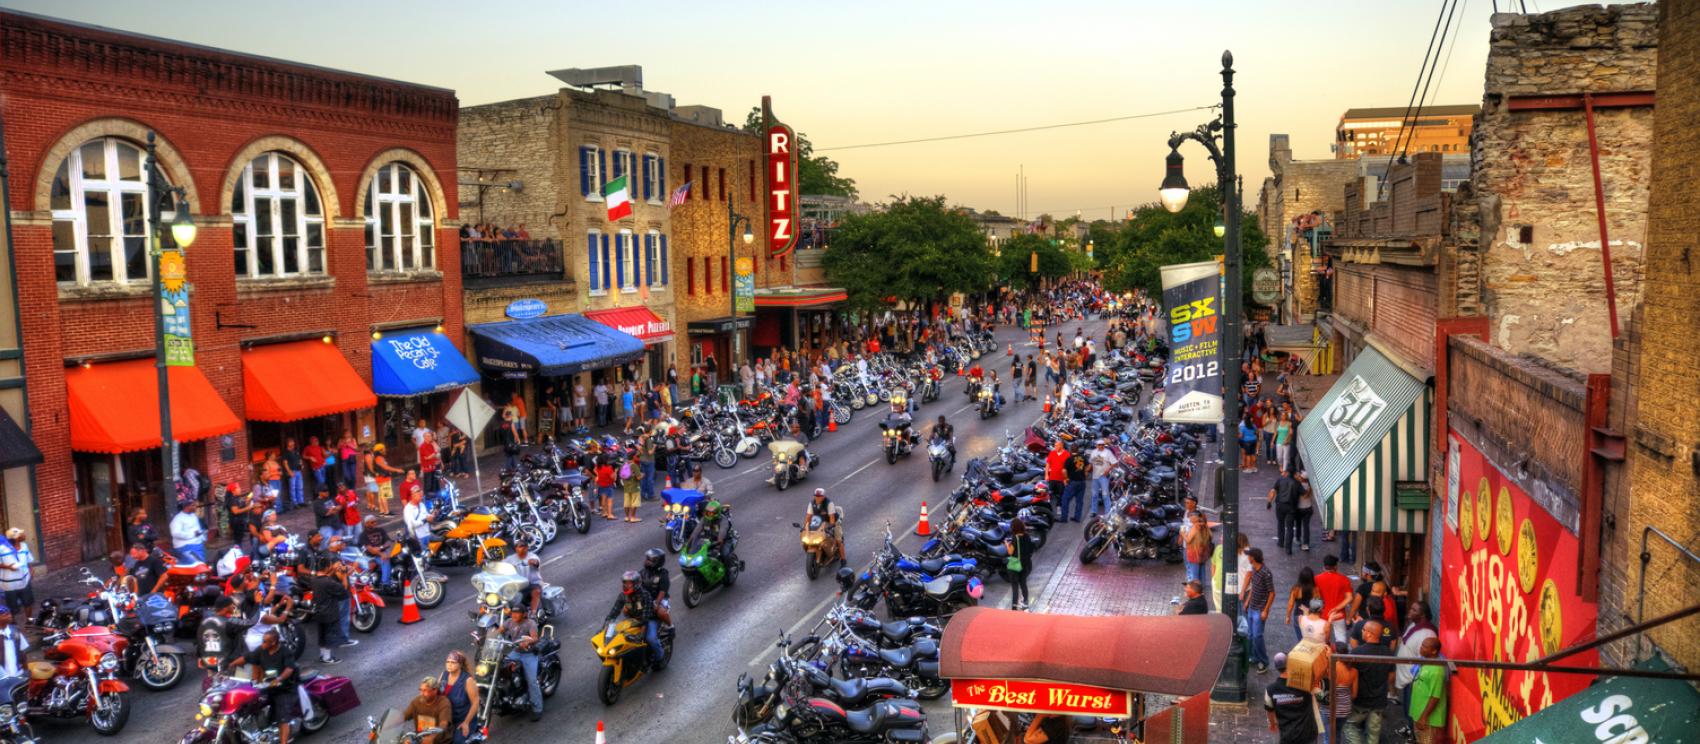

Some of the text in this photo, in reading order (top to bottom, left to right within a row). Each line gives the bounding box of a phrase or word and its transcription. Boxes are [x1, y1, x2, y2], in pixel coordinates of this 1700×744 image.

[770, 133, 791, 240] RITZ
[388, 335, 431, 351] The Old
[1174, 344, 1194, 355] MUSIC
[1200, 339, 1218, 349] FILM
[395, 348, 428, 360] Pecan
[1174, 347, 1217, 363] INTERACTIVE
[1172, 361, 1219, 384] 2012
[1329, 391, 1382, 434] 311
[966, 684, 1112, 710] The Best Wurst
